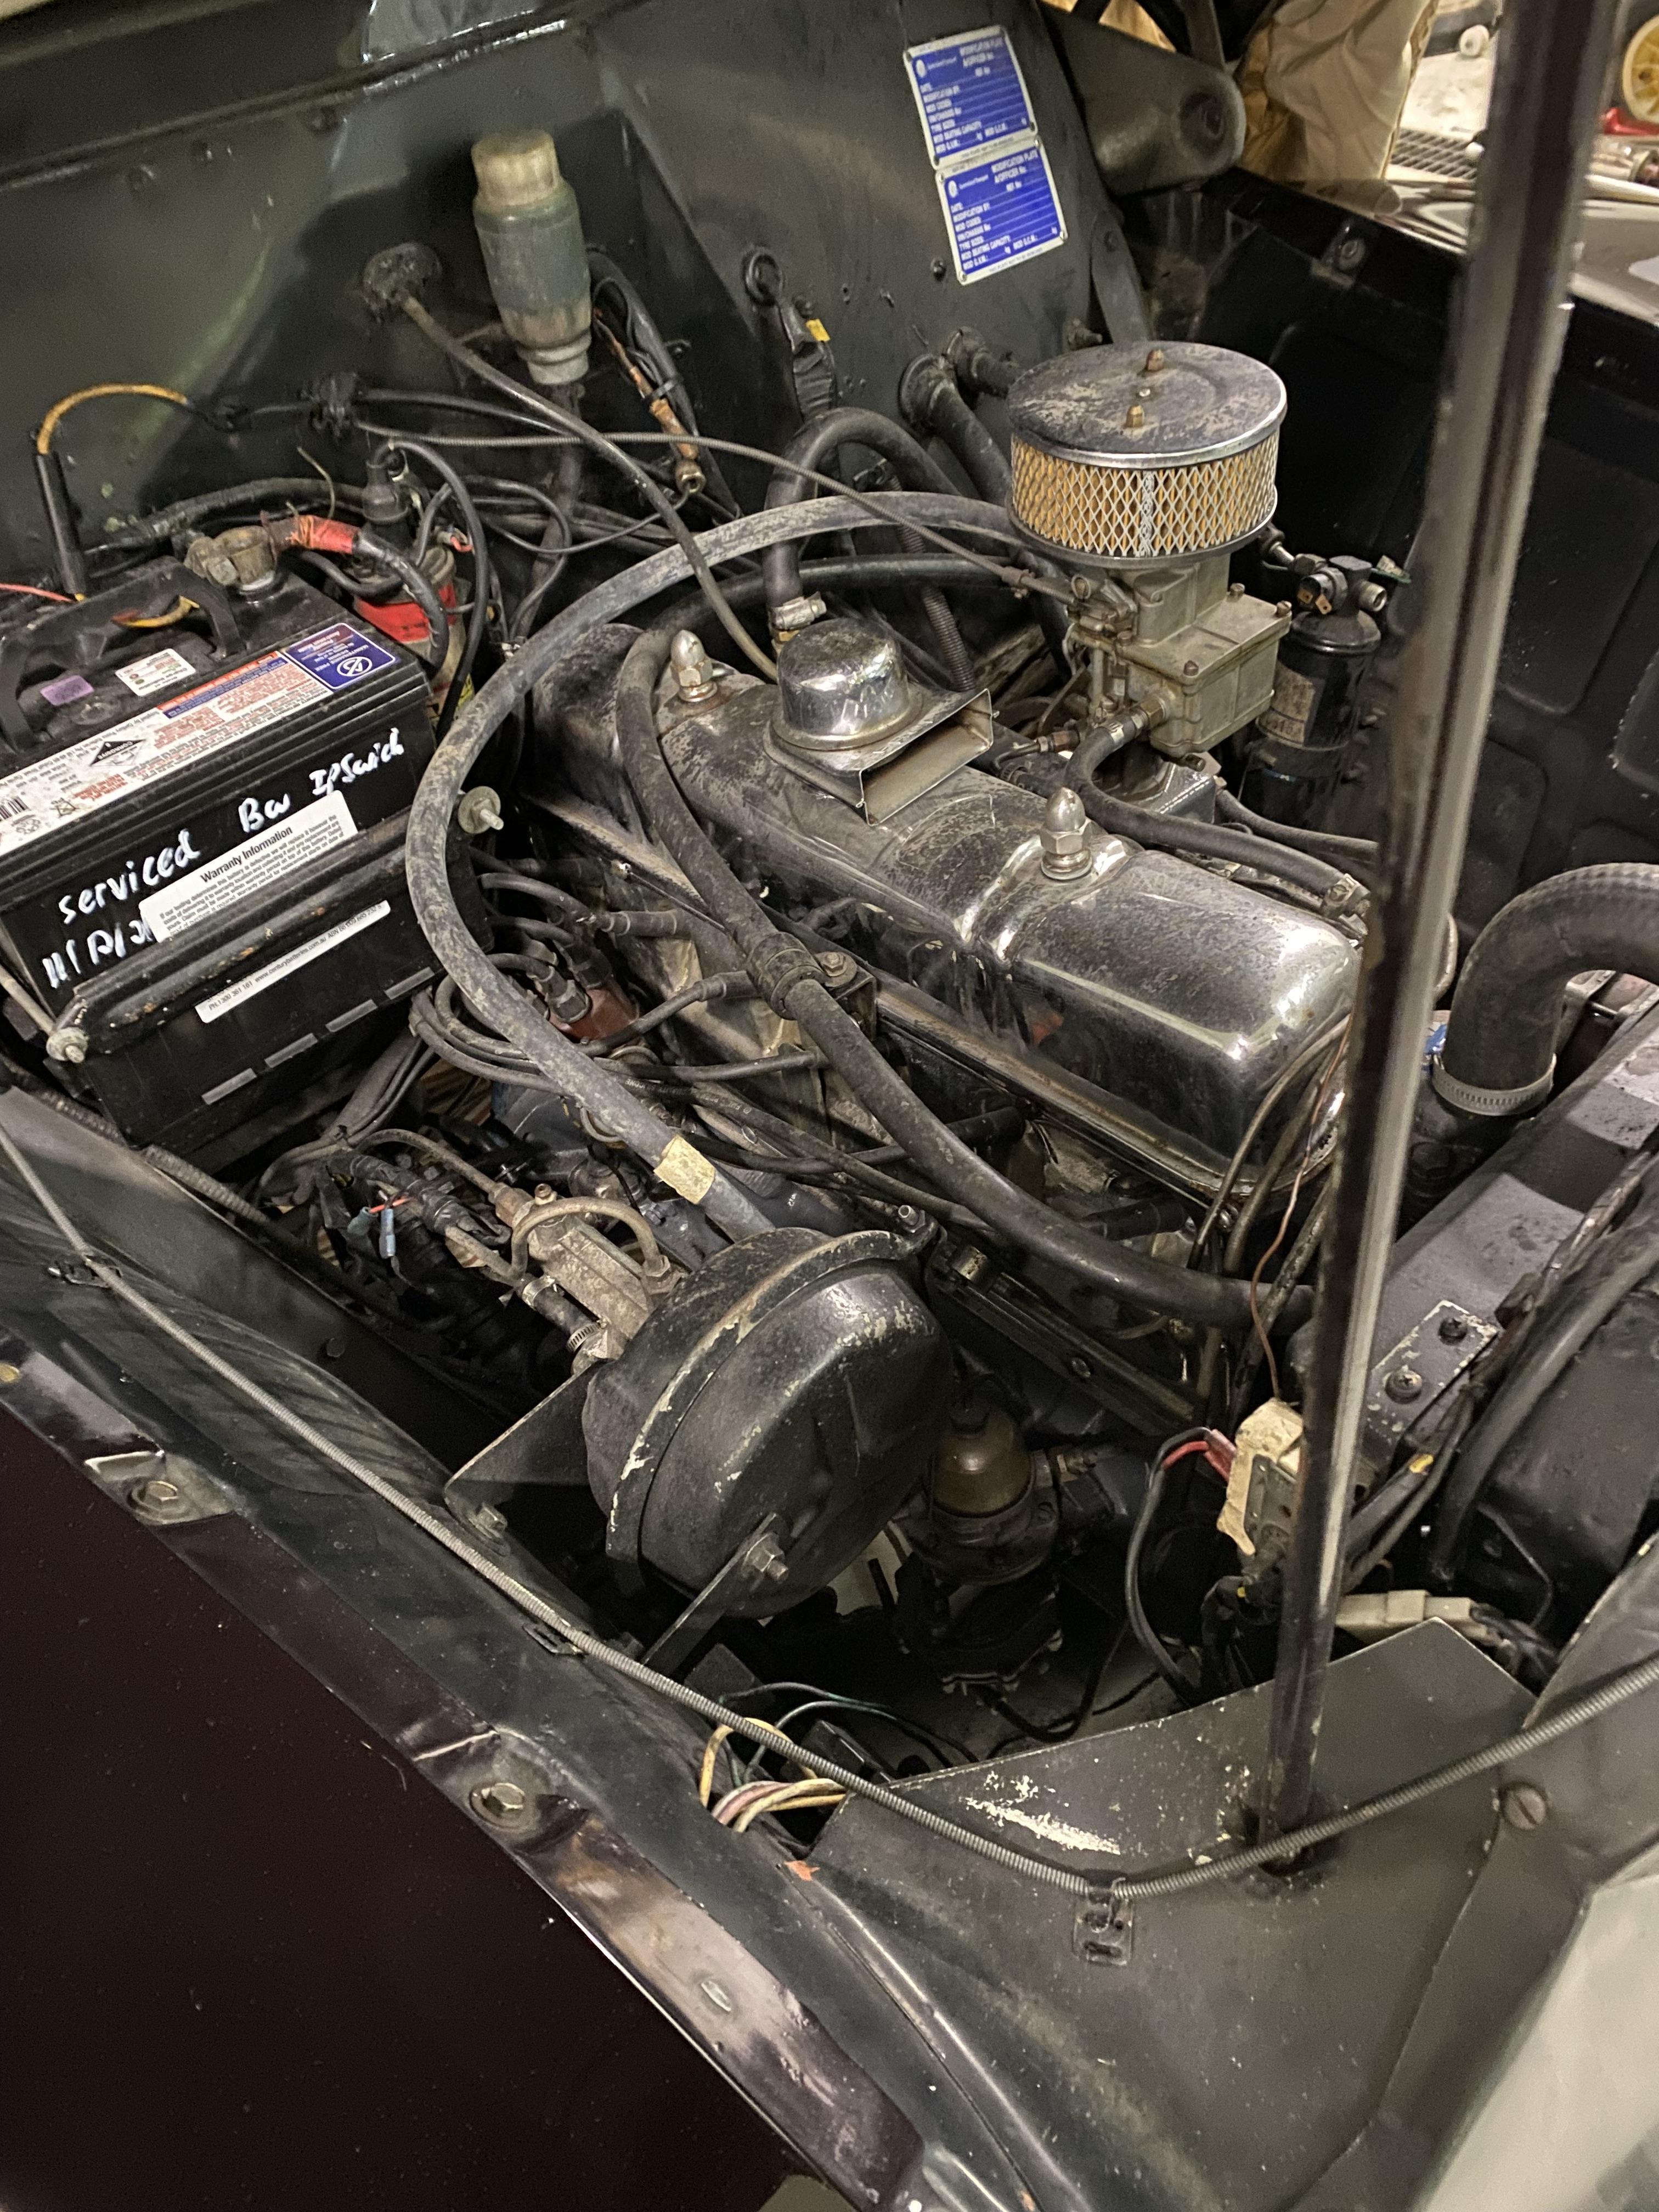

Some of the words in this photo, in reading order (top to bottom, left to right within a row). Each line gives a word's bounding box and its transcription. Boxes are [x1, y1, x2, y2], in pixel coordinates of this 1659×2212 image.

[95, 739, 133, 761] CORROSIVE
[199, 853, 244, 885] Warranty
[241, 824, 294, 860] Information
[230, 986, 242, 997] 361
[242, 979, 253, 990] 161
